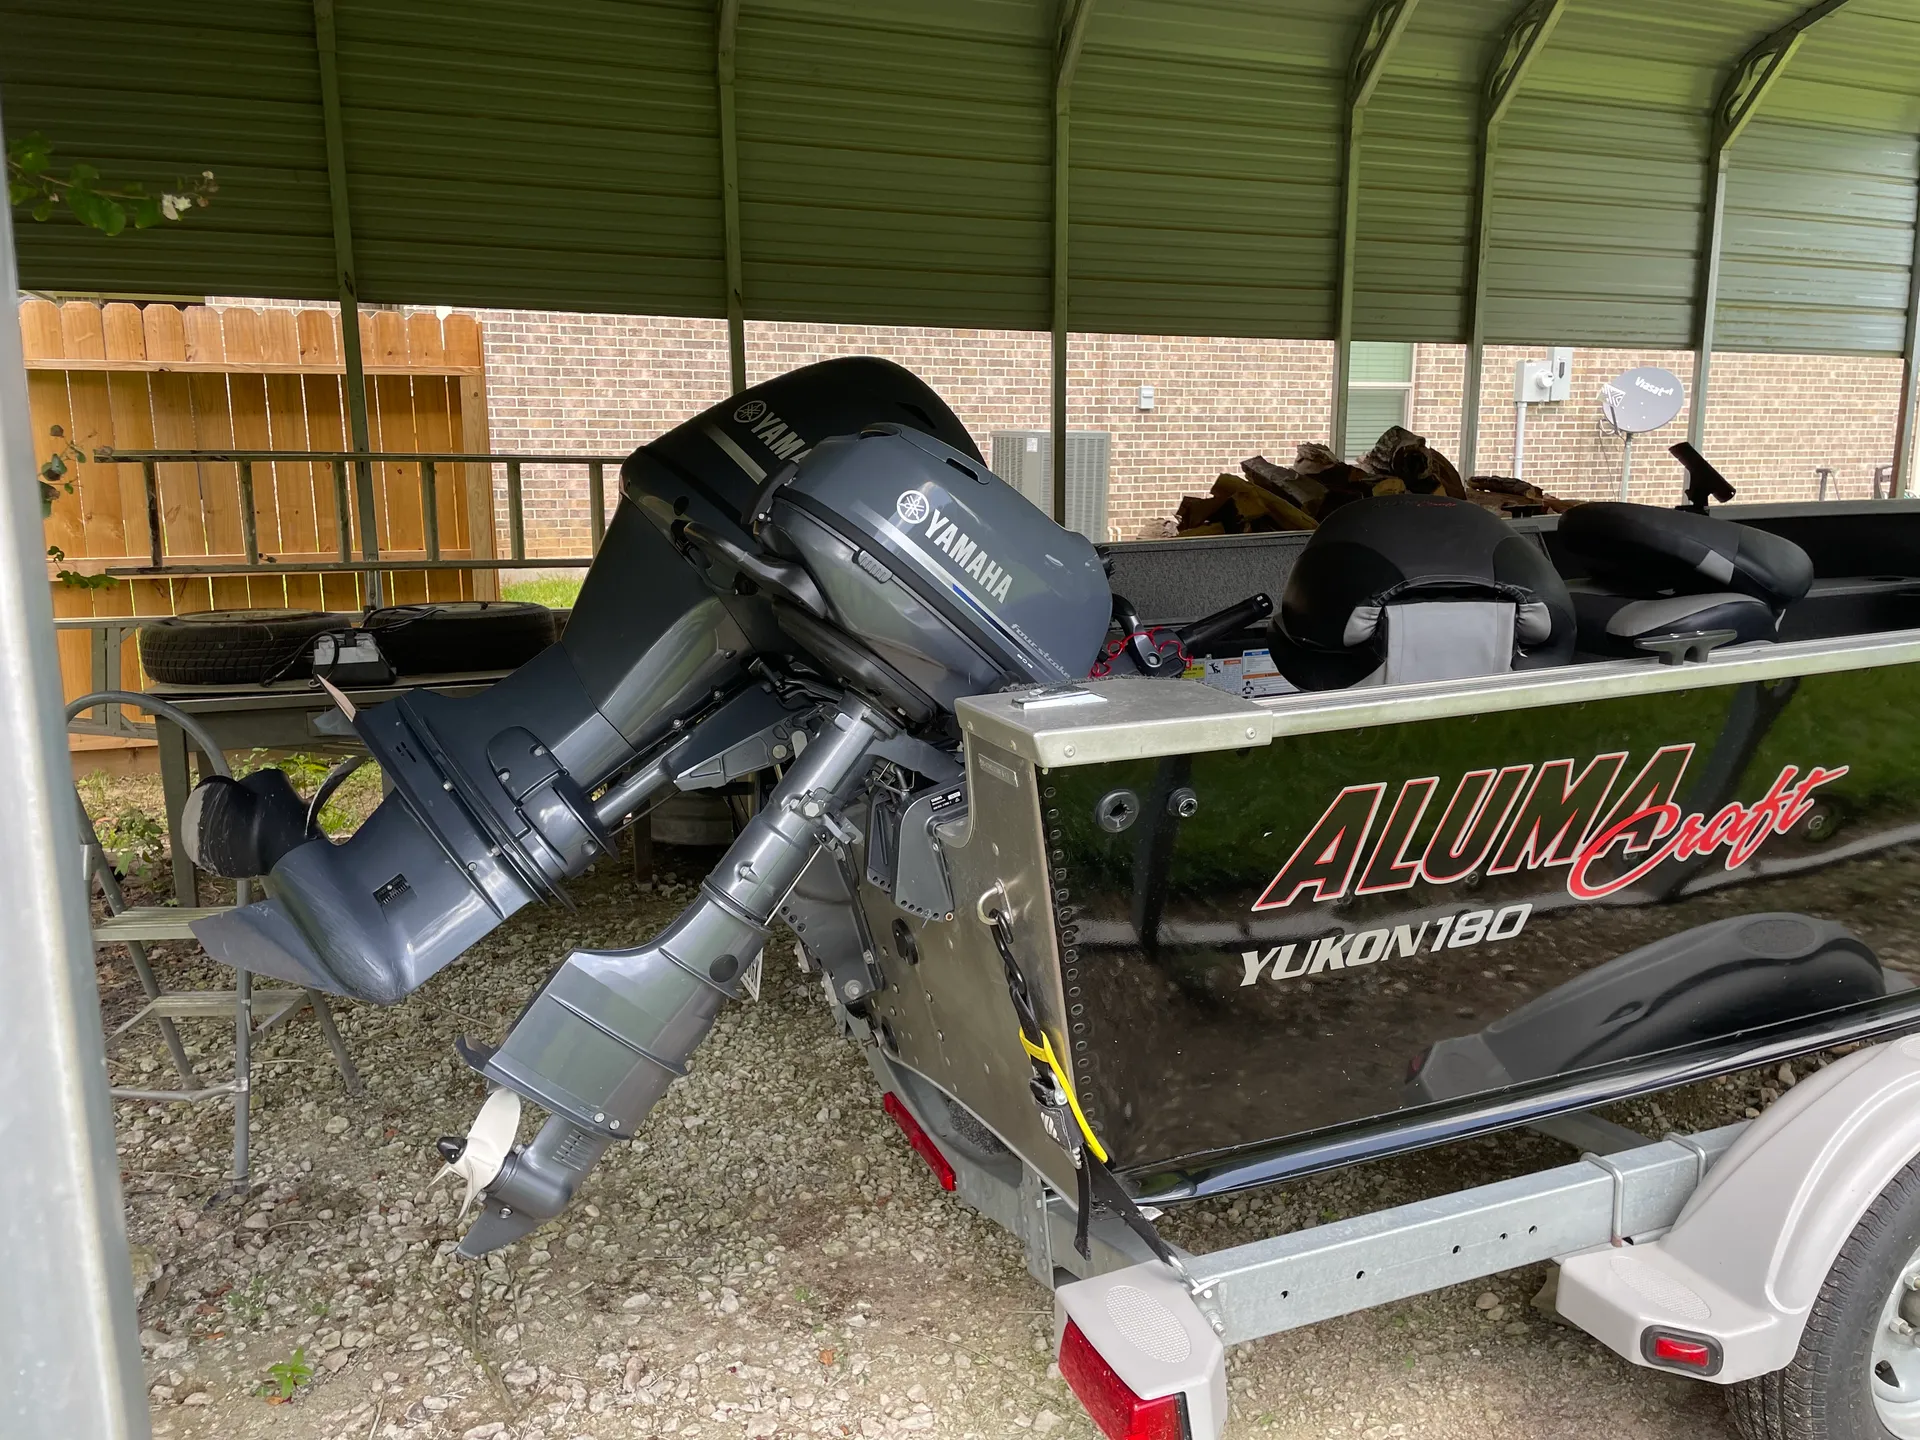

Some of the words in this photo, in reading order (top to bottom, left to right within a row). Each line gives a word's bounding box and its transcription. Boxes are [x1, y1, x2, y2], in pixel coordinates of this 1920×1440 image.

[1635, 376, 1665, 397] Viasat
[924, 508, 1013, 604] YAMAHA
[1251, 743, 1696, 911] ALUMA
[1567, 764, 1850, 900] Craft
